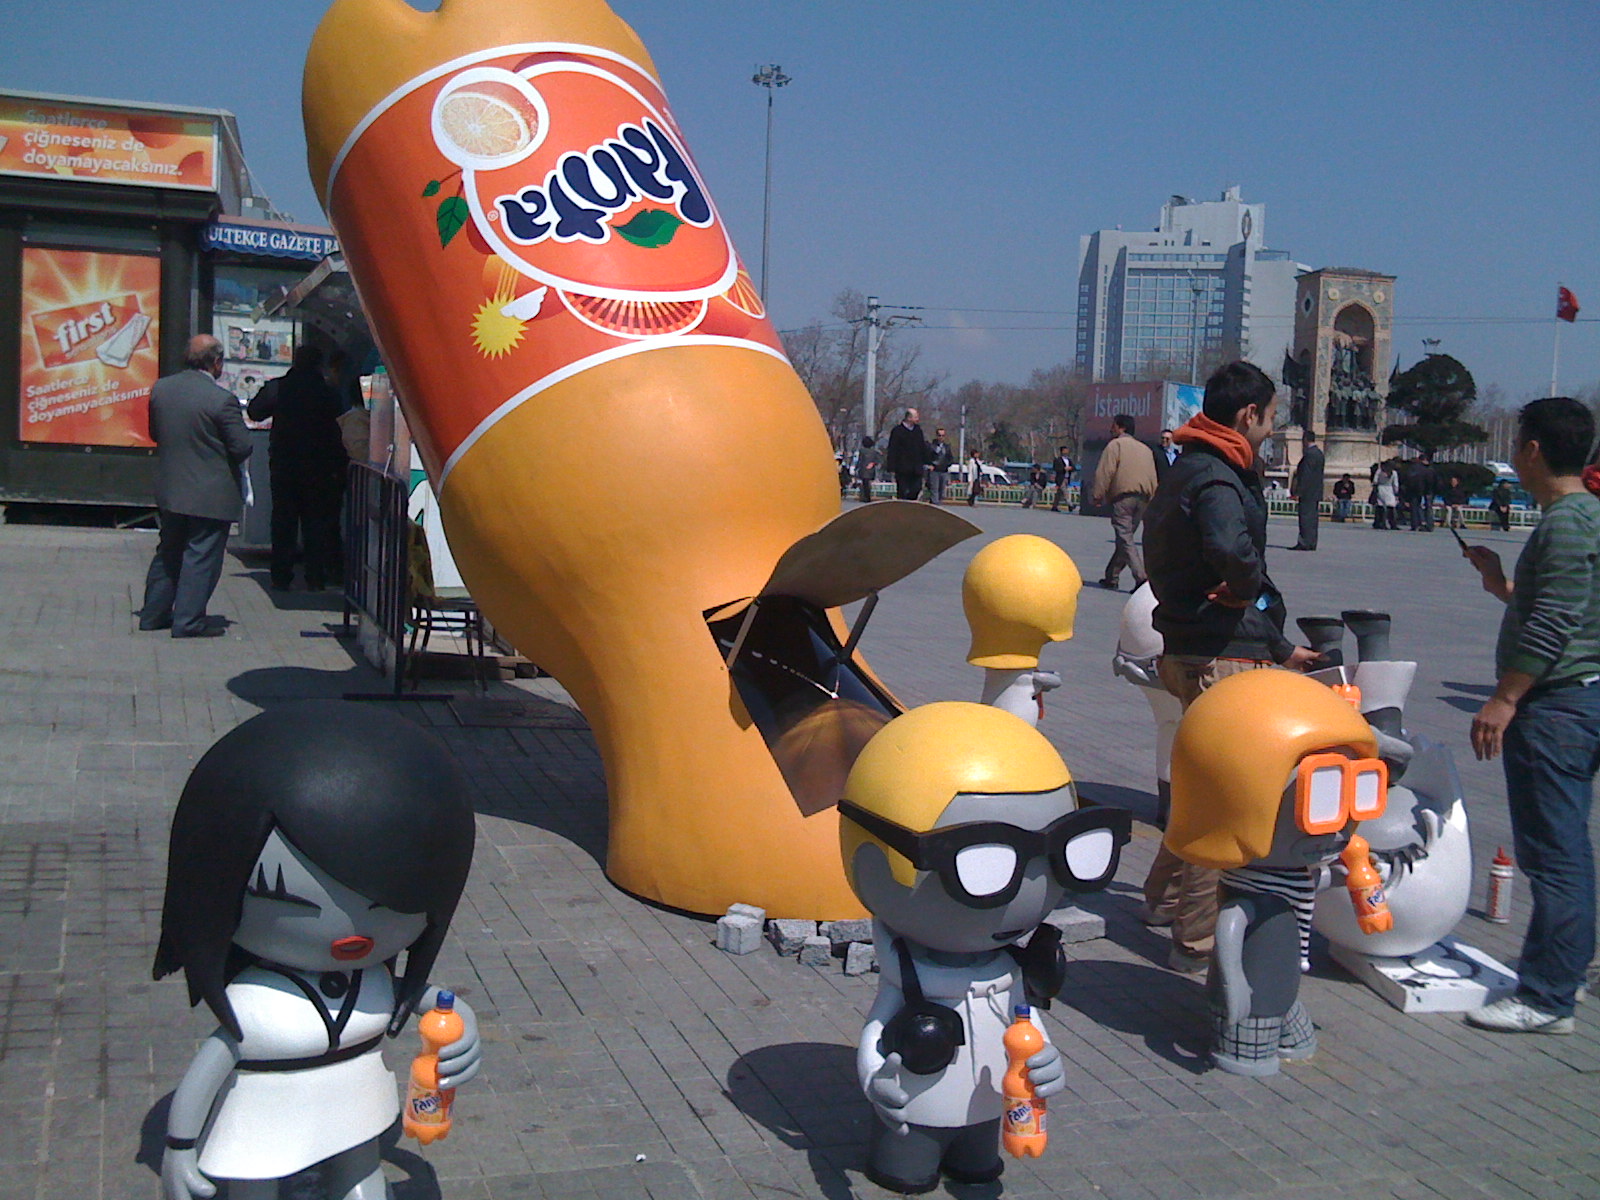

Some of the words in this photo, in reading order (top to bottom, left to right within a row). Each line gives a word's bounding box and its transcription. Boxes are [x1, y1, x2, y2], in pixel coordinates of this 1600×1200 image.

[26, 109, 108, 131] Saatlerce
[24, 129, 117, 149] çiğneseniz
[121, 137, 145, 152] de
[23, 149, 183, 176] doyamayacaksınız.
[497, 118, 712, 242] Fanta
[270, 232, 321, 254] GAZETE
[53, 302, 116, 353] first
[27, 376, 89, 398] Saatlerce
[28, 386, 101, 412] çiğneseniz
[102, 380, 120, 393] de
